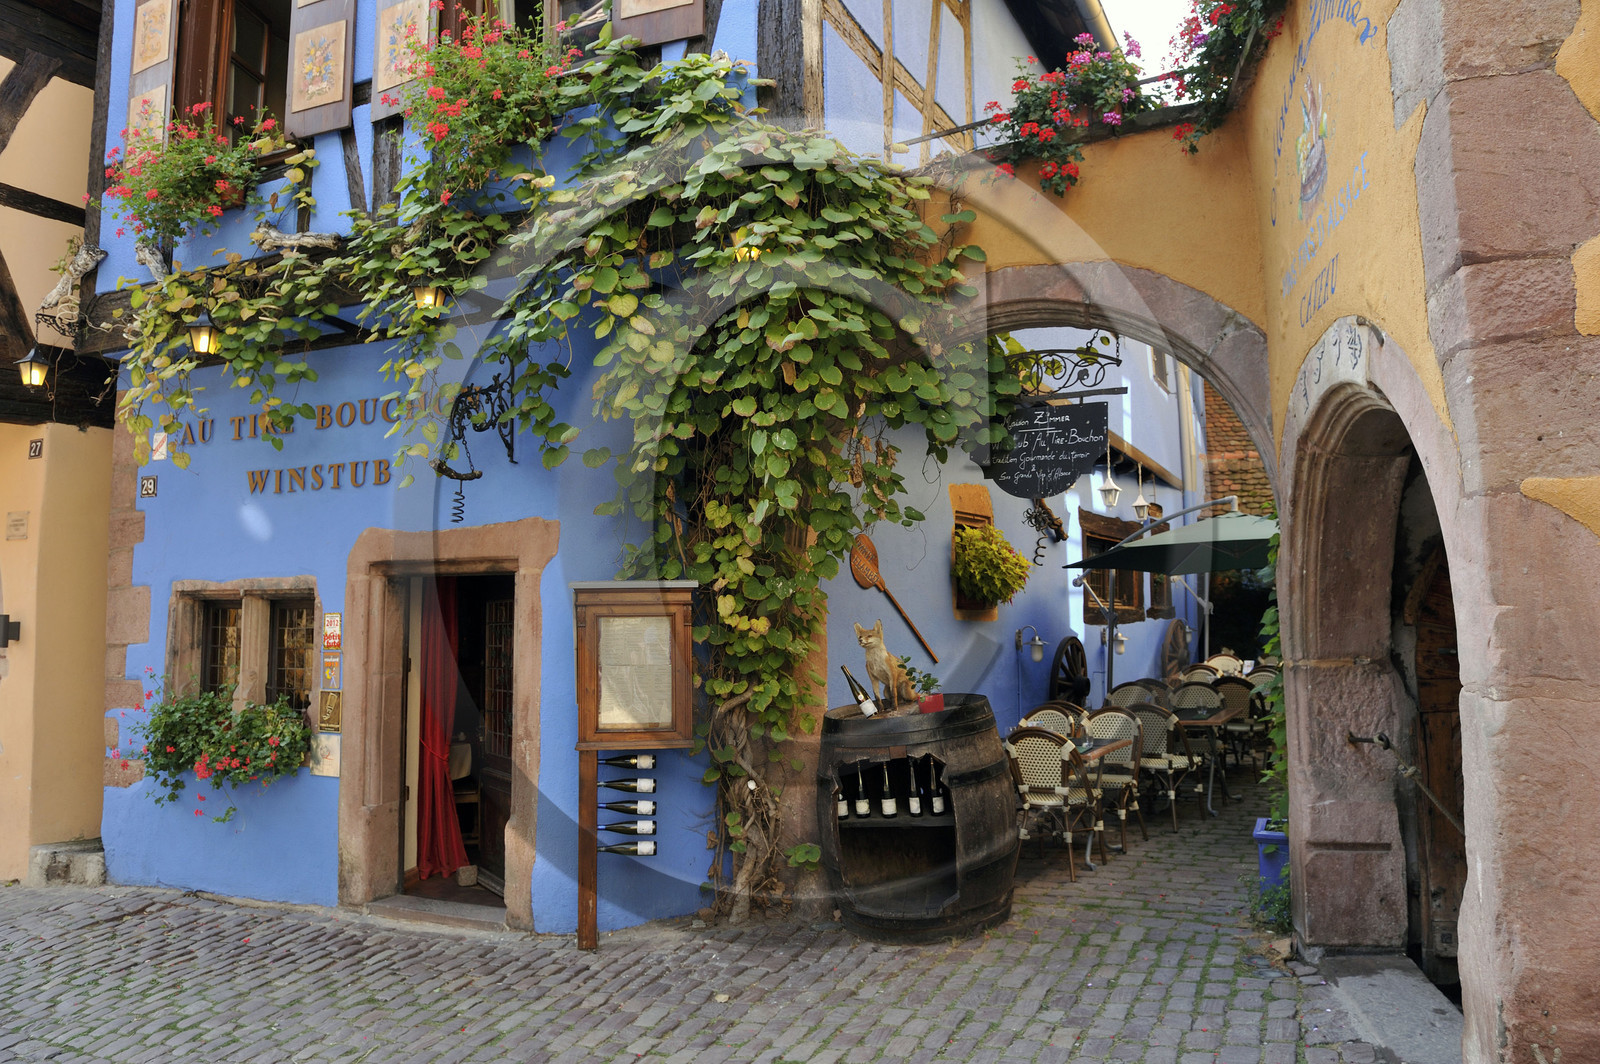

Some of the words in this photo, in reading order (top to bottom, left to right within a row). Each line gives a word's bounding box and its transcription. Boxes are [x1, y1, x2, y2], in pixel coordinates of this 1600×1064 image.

[1298, 227, 1316, 276] FINS
[1316, 151, 1370, 249] D'ALSACE
[180, 419, 214, 446] AU
[1032, 432, 1046, 451] Au
[30, 442, 41, 456] 27
[142, 479, 154, 494] 29
[247, 459, 391, 495] WINSTUB
